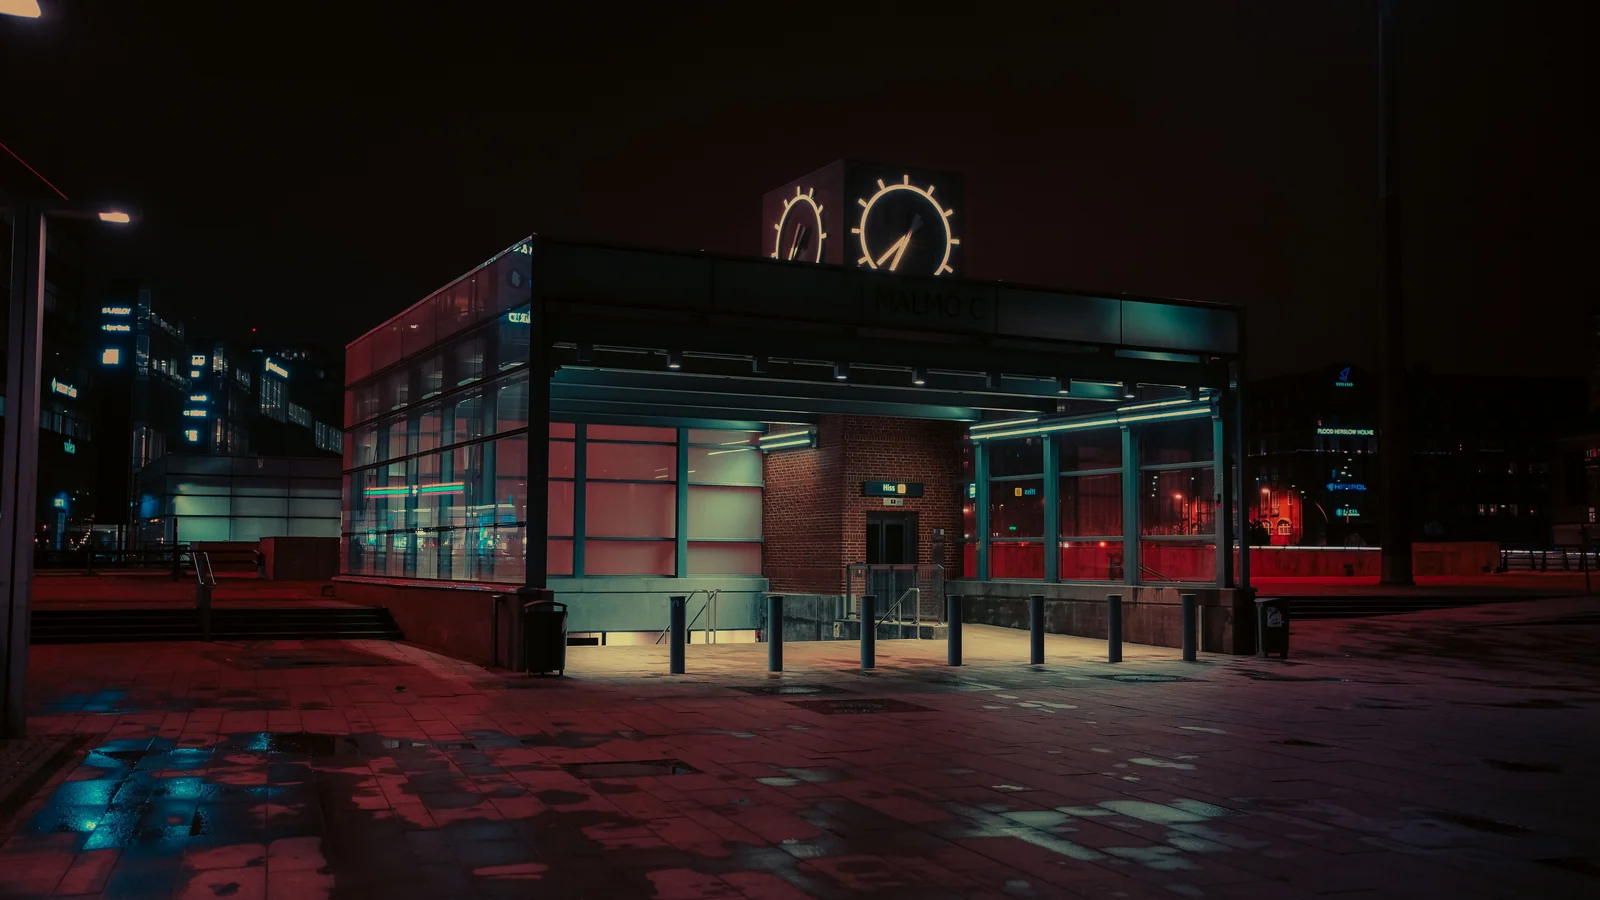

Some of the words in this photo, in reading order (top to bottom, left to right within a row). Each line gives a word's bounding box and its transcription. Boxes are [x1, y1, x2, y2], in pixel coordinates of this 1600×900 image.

[875, 286, 961, 318] MALMÖ
[970, 297, 985, 320] C
[882, 483, 896, 492] Hiss
